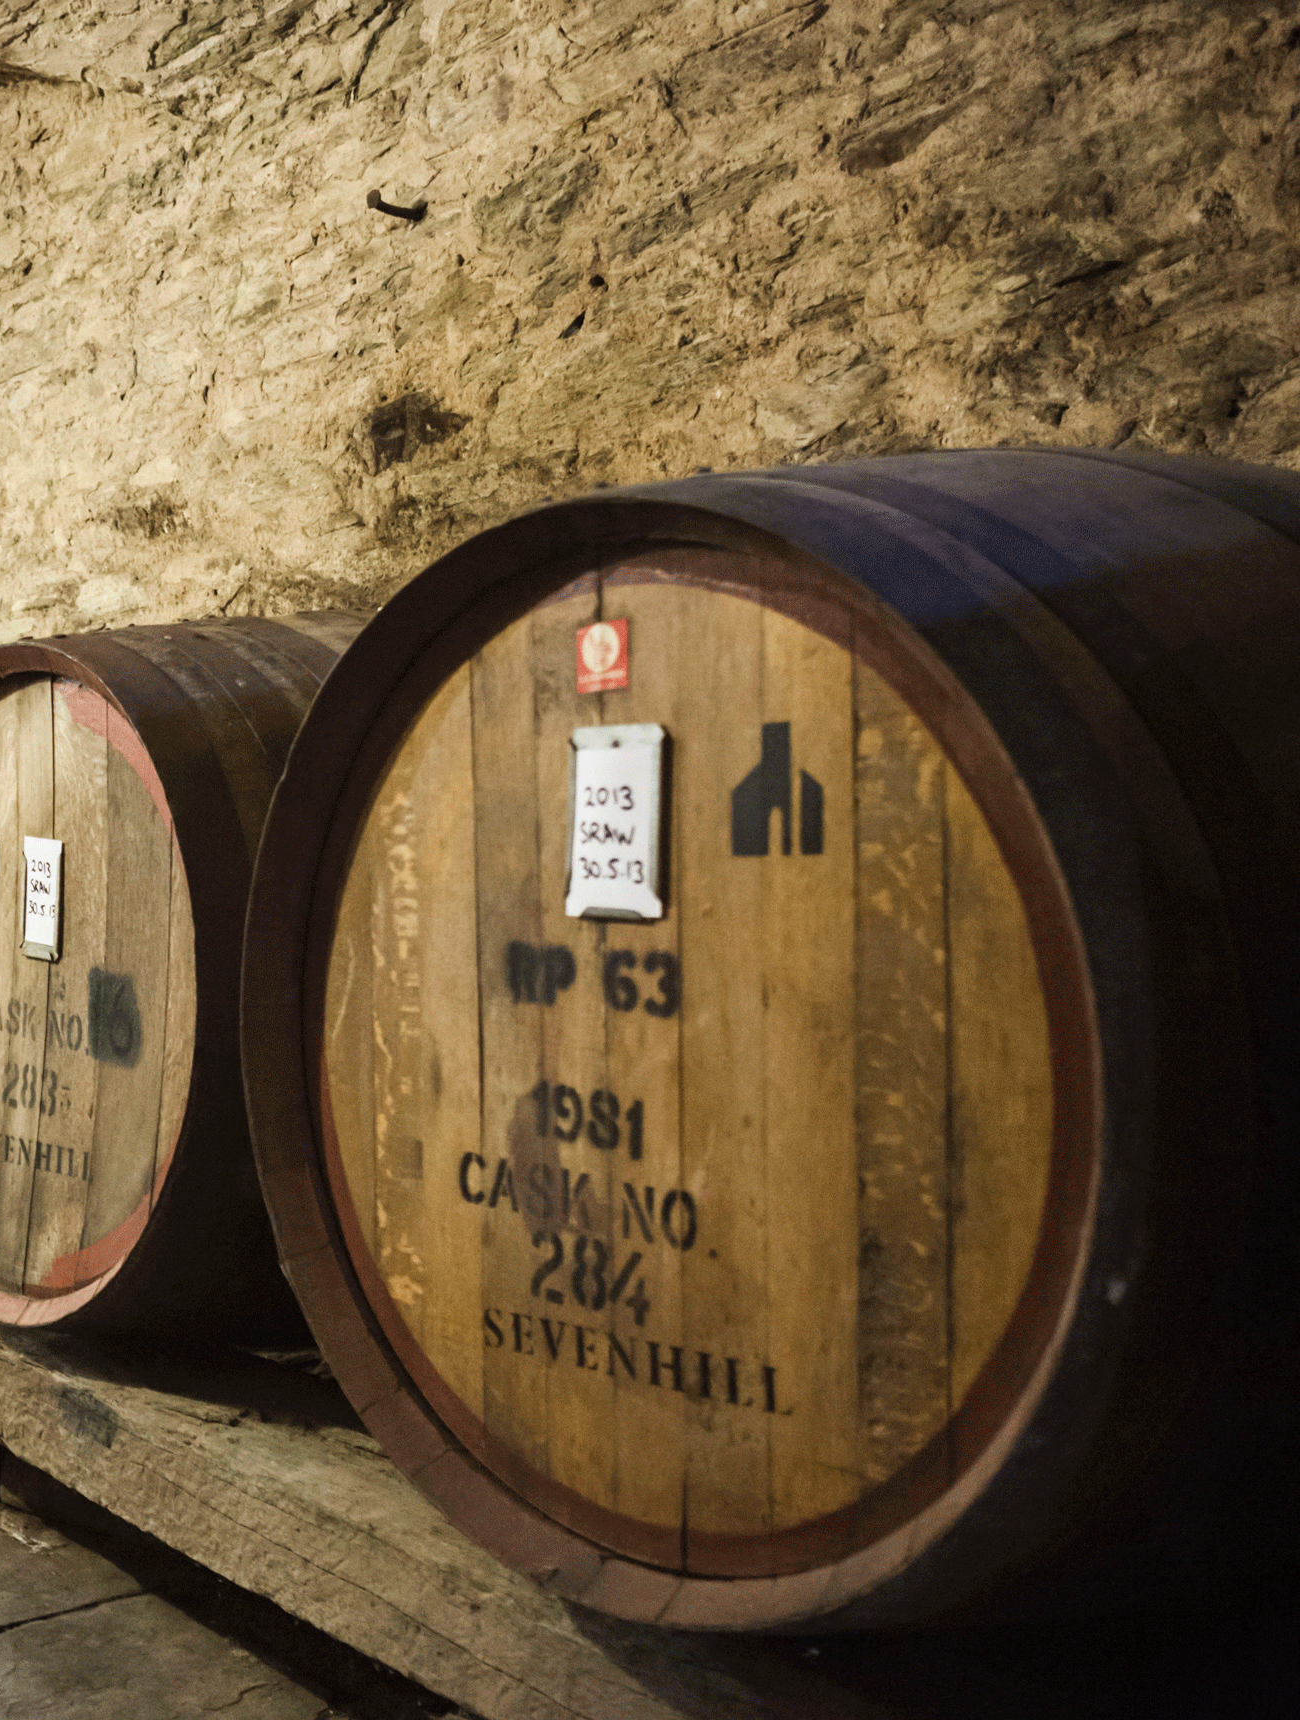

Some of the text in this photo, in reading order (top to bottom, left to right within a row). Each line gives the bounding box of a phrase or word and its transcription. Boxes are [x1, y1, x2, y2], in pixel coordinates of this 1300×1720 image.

[585, 785, 634, 811] 2013
[31, 859, 51, 878] 2013
[602, 949, 682, 1018] 63
[2, 1062, 59, 1117] 283
[531, 1079, 644, 1161] 1981
[459, 1151, 606, 1230] CASK
[530, 1230, 651, 1328] 284
[483, 1308, 794, 1417] SEVENHILL
